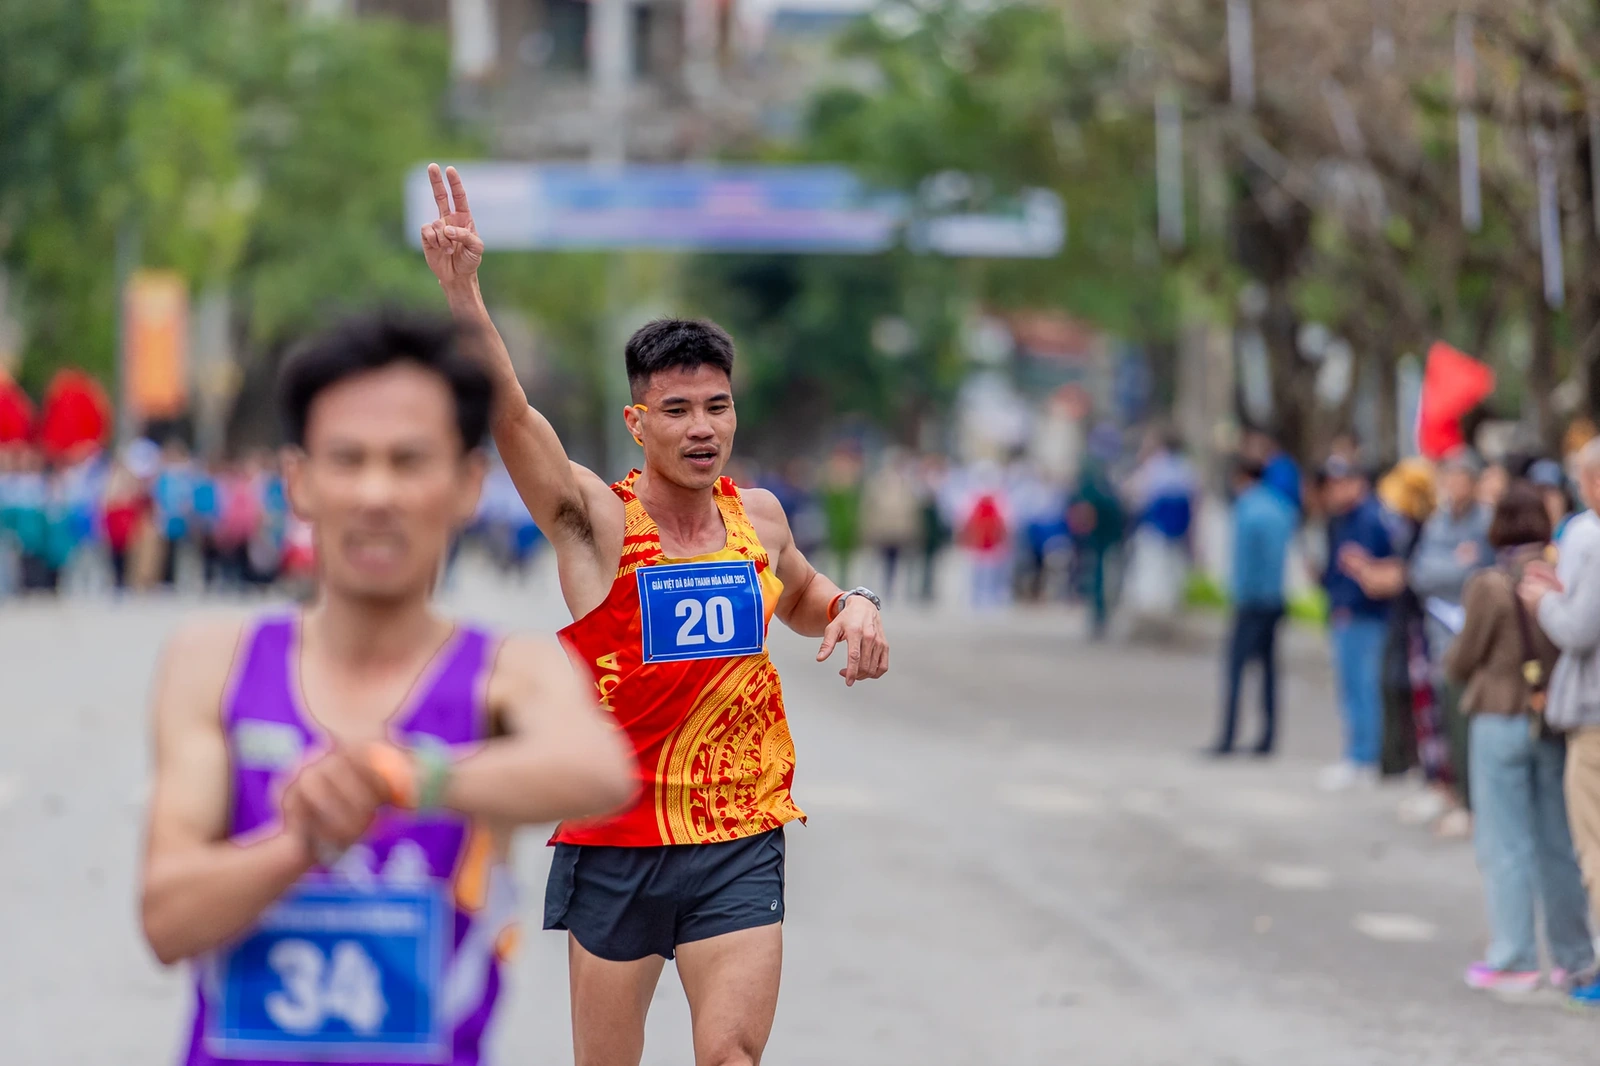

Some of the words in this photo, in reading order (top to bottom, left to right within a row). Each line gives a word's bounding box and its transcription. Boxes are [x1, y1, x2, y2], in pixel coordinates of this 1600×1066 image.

[663, 578, 674, 590] VIỆT
[684, 577, 694, 587] BÁO
[695, 577, 711, 587] THANH
[711, 575, 722, 585] HÓA
[722, 574, 734, 584] NĂM
[734, 574, 746, 584] 2025
[675, 596, 735, 646] 20
[264, 938, 389, 1036] 34
